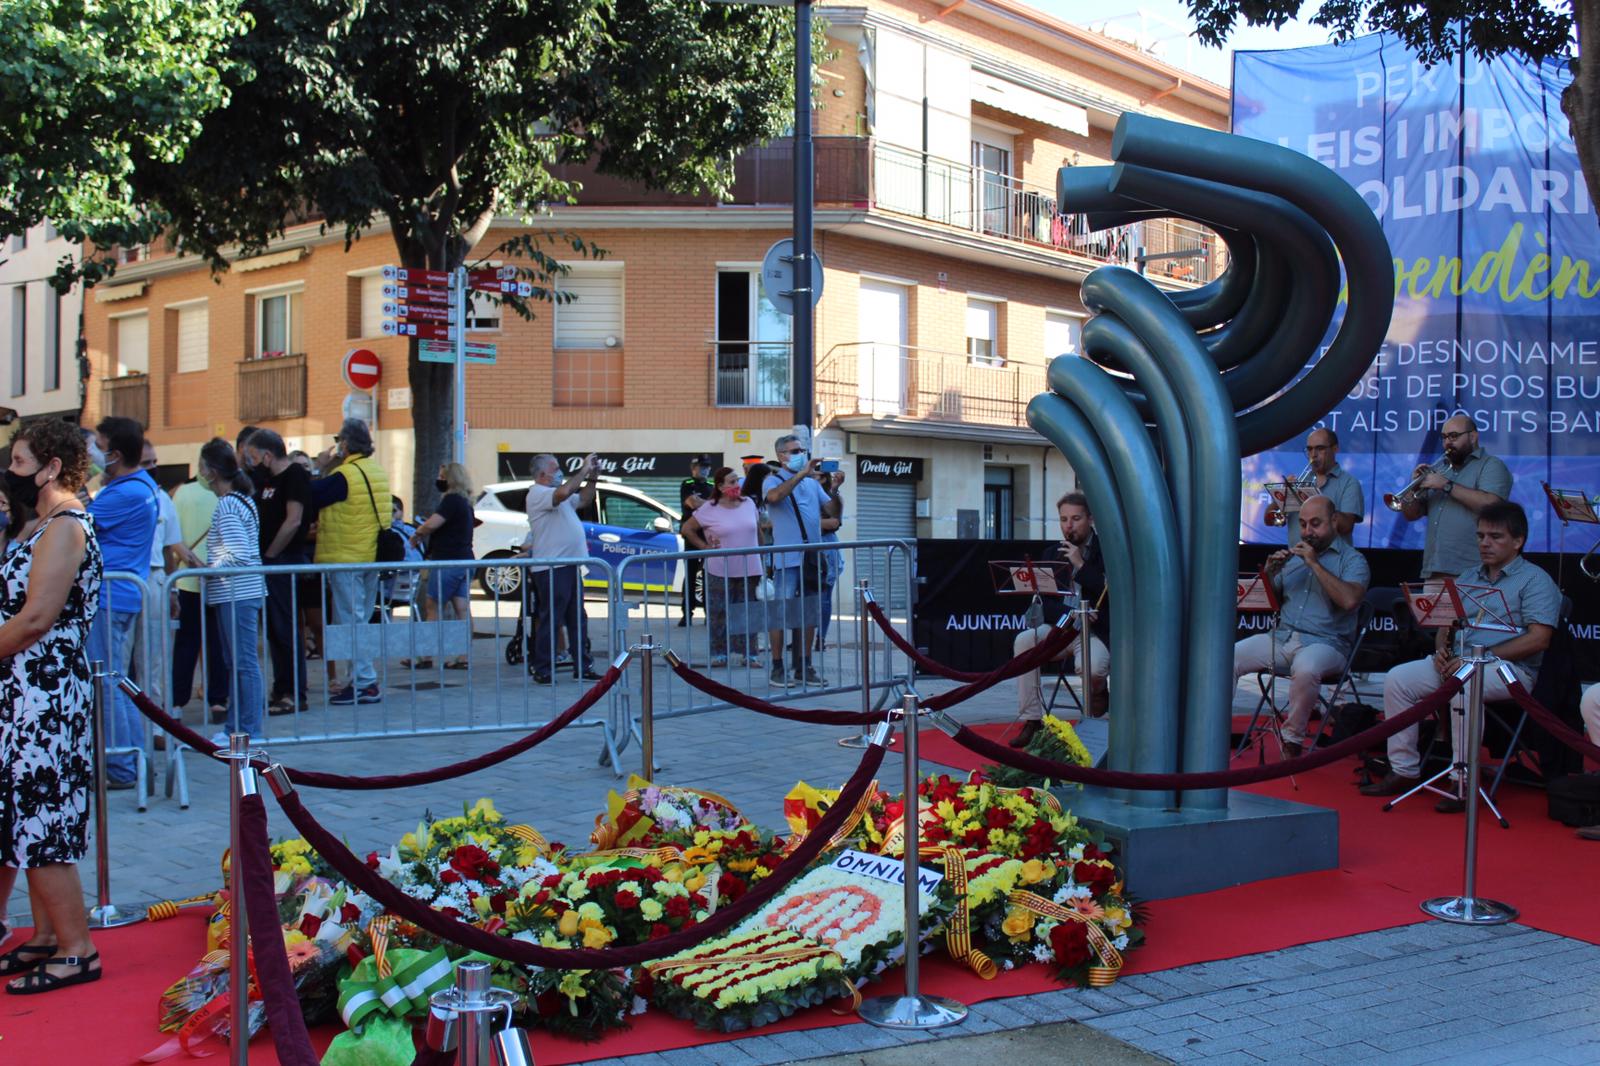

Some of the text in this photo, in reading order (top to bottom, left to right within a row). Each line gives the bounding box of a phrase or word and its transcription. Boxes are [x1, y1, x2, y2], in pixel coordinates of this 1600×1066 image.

[1356, 61, 1437, 108] PER
[1278, 126, 1382, 169] EIS
[1396, 119, 1407, 160] I
[1398, 339, 1598, 365] DESNONAME
[1406, 374, 1441, 398] DE
[1452, 373, 1545, 399] PISOS
[1556, 375, 1600, 399] BU
[1350, 410, 1399, 432] ALS
[565, 456, 657, 474] Ptty Girl
[860, 459, 913, 476] Pretty Girl
[946, 614, 1029, 631] AJUNTAM
[1237, 615, 1281, 630] AJUN
